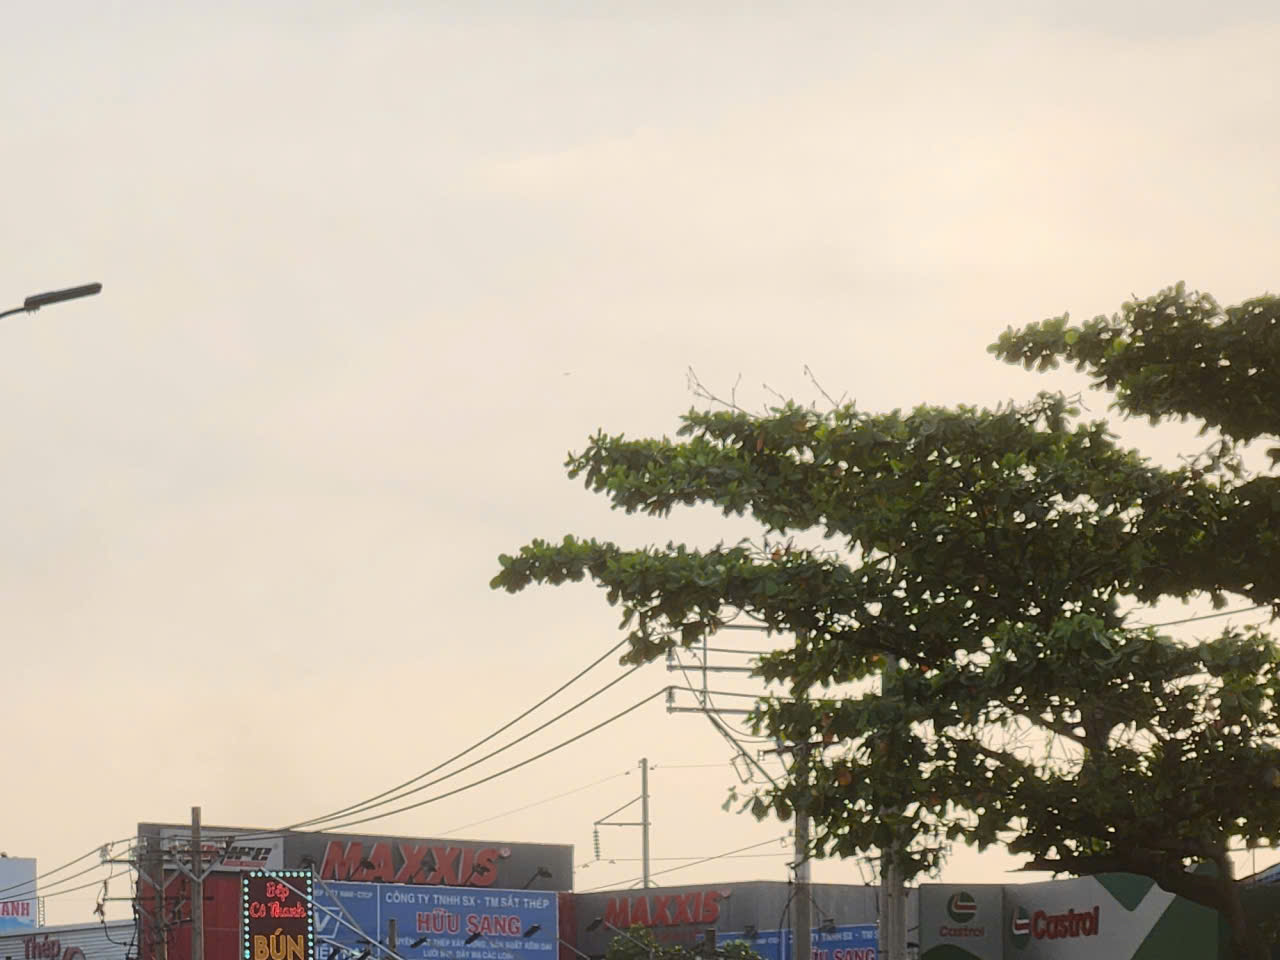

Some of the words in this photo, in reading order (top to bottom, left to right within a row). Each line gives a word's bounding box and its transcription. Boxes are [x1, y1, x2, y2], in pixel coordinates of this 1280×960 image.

[320, 841, 500, 887] MAXXIS
[385, 890, 416, 905] CÔNG
[417, 894, 429, 905] TY
[432, 894, 460, 906] TNHH
[523, 894, 550, 909] THÉP
[605, 892, 721, 928] MAXXIS
[466, 914, 521, 937] SANG
[939, 926, 985, 937] Castrol
[1031, 905, 1100, 940] Castrol
